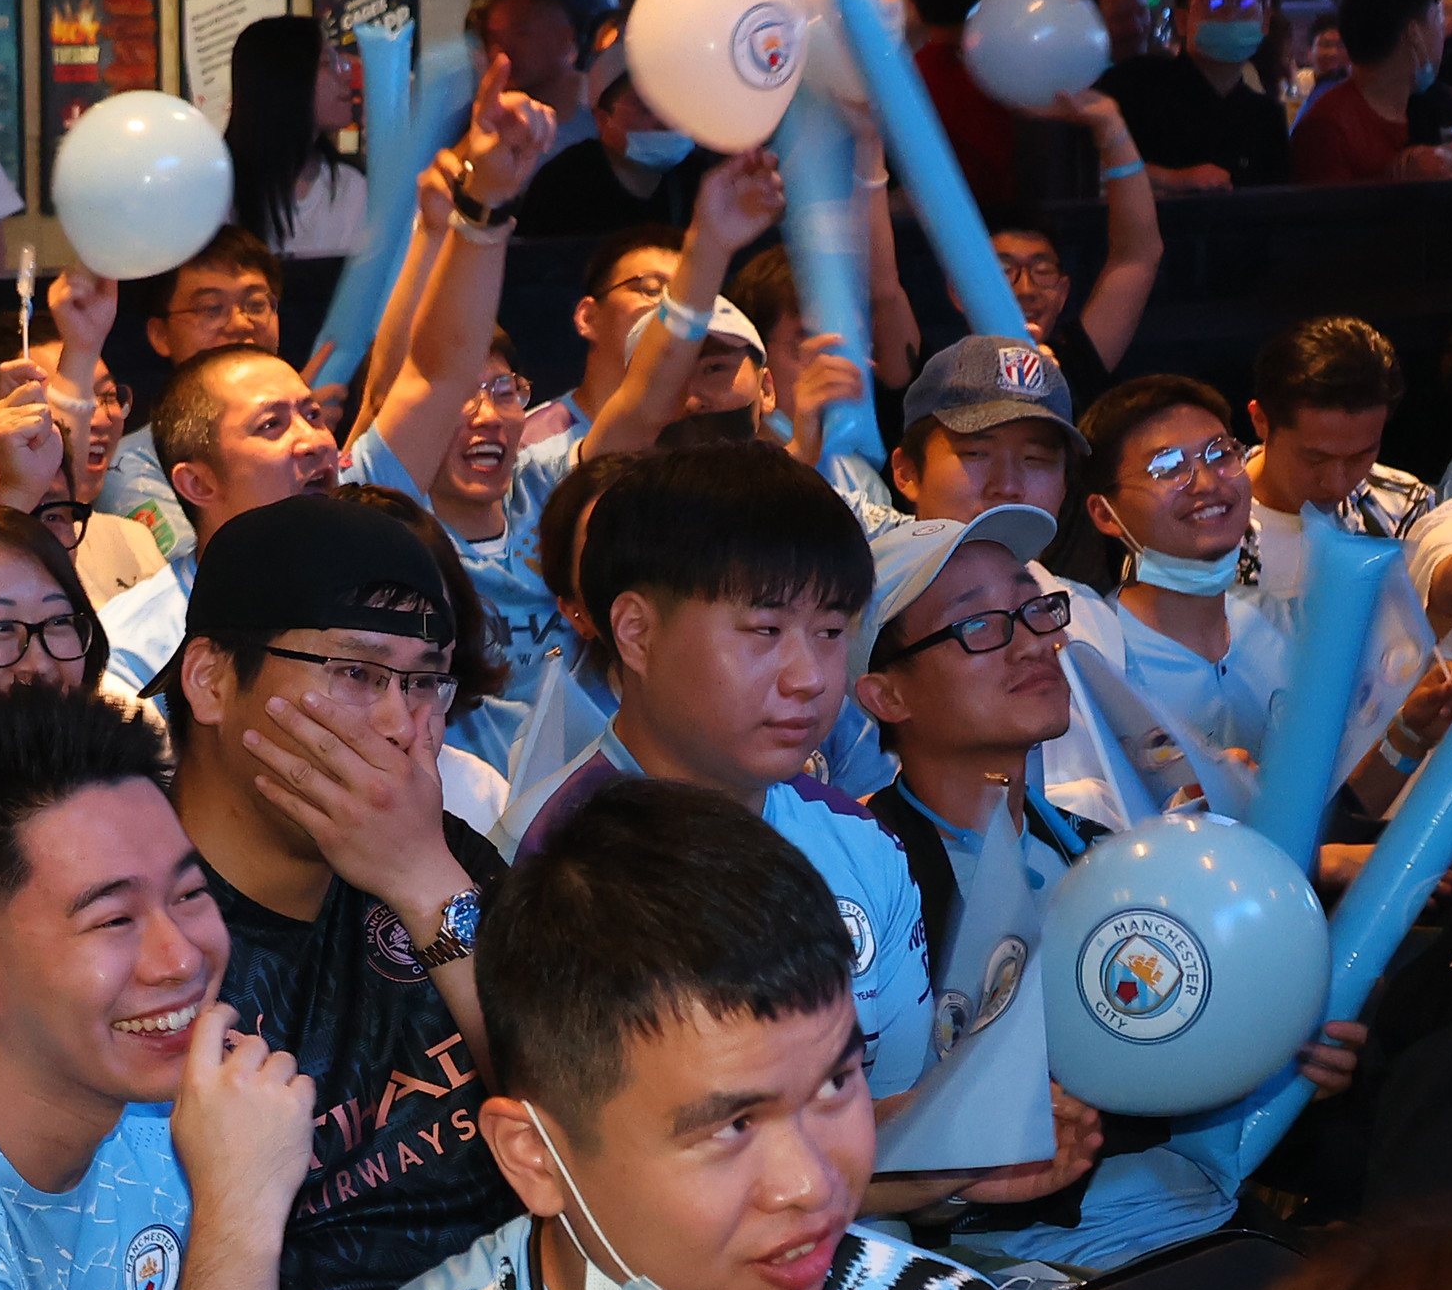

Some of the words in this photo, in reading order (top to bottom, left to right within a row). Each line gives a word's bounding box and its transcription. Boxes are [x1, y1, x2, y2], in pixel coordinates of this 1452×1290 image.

[1112, 918, 1199, 999] MANCHESTER
[1096, 1000, 1129, 1031] CITY
[127, 1231, 176, 1275] MANCHESTER
